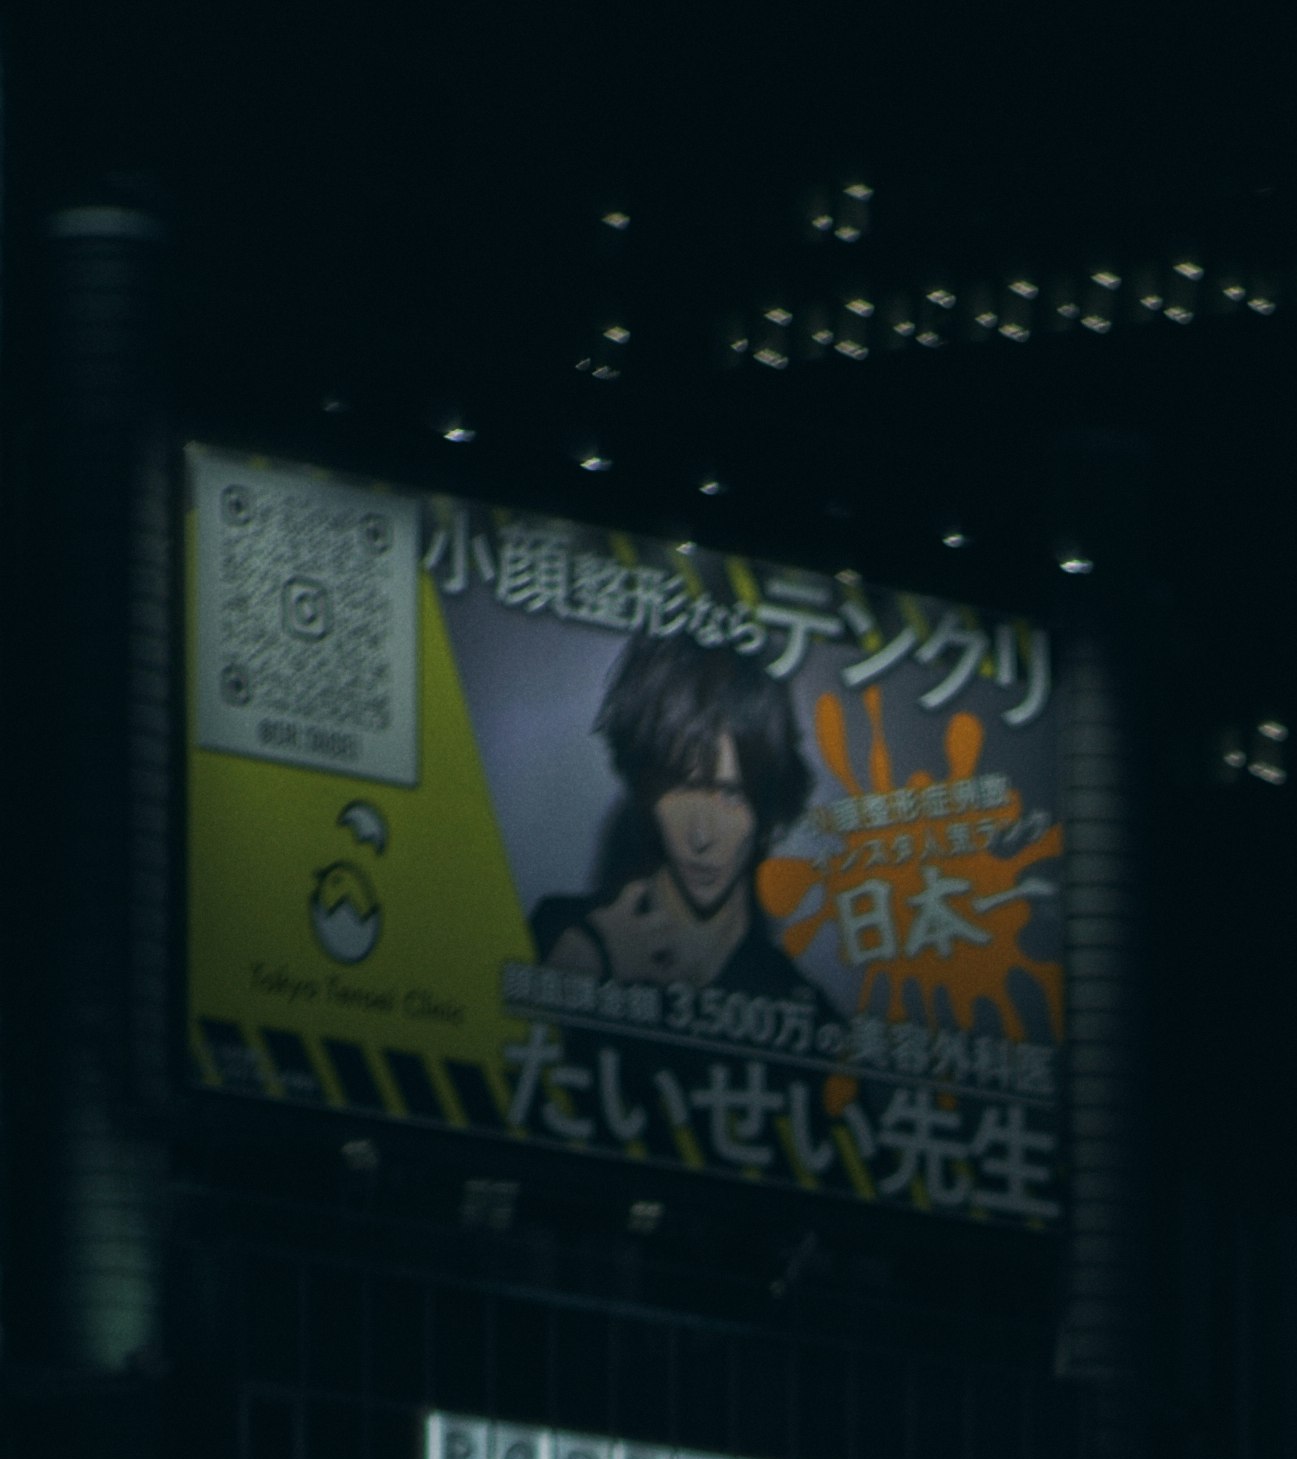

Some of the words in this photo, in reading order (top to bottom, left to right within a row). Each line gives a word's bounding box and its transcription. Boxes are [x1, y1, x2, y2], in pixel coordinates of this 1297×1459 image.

[836, 865, 1058, 965] 日本一
[503, 1022, 1062, 1219] たいせい先生
